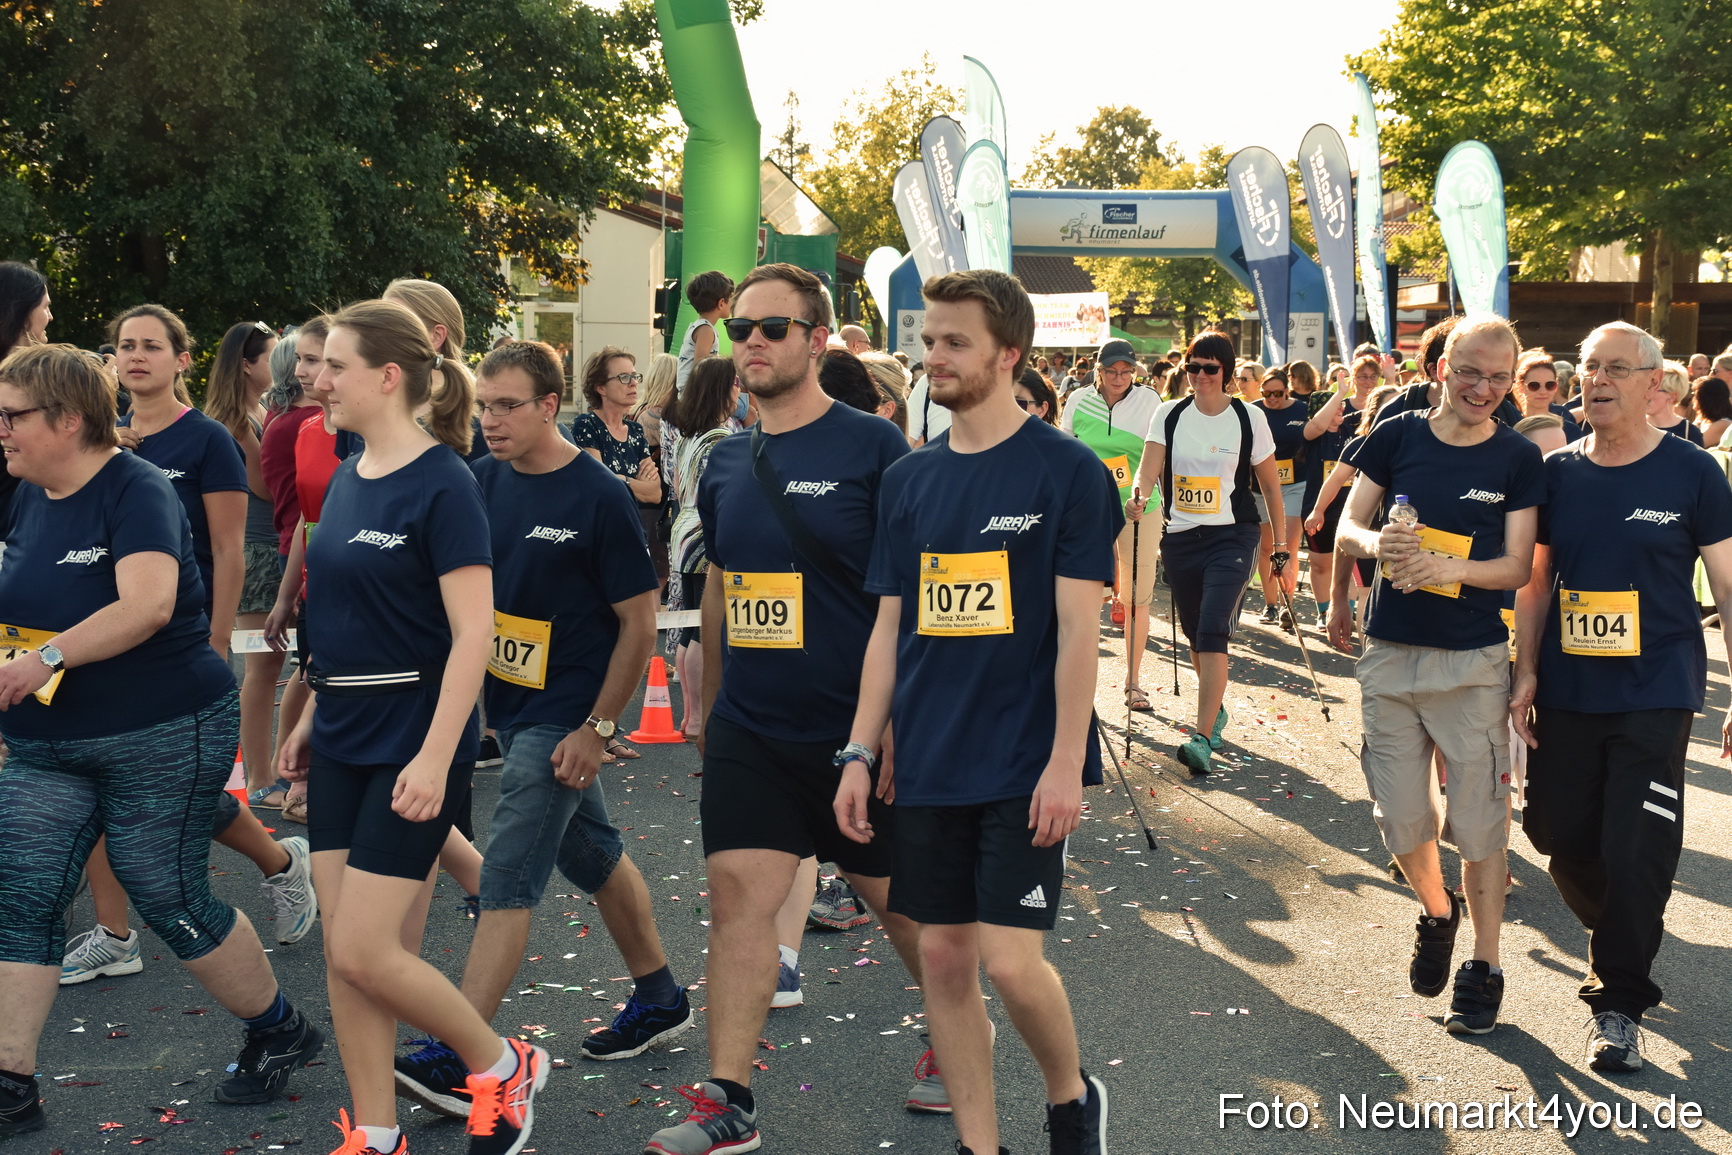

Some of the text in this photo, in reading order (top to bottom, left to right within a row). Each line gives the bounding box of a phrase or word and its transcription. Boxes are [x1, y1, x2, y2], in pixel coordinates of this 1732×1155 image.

[1109, 208, 1136, 217] Fischer
[1089, 224, 1167, 240] firmenlauf
[1178, 488, 1213, 504] 2010
[1459, 488, 1496, 501] JURA
[1625, 508, 1665, 521] JURA
[525, 525, 562, 539] JURA
[980, 516, 1025, 534] JURA
[348, 529, 392, 543] JURA
[56, 550, 92, 565] JURA
[926, 582, 996, 613] 1072
[731, 599, 789, 627] 1109
[936, 614, 954, 622] Benz
[1566, 613, 1628, 637] 1104
[1573, 637, 1596, 645] Reulein
[493, 635, 536, 667] 107
[499, 661, 521, 673] Gregor
[1019, 898, 1047, 909] adidas
